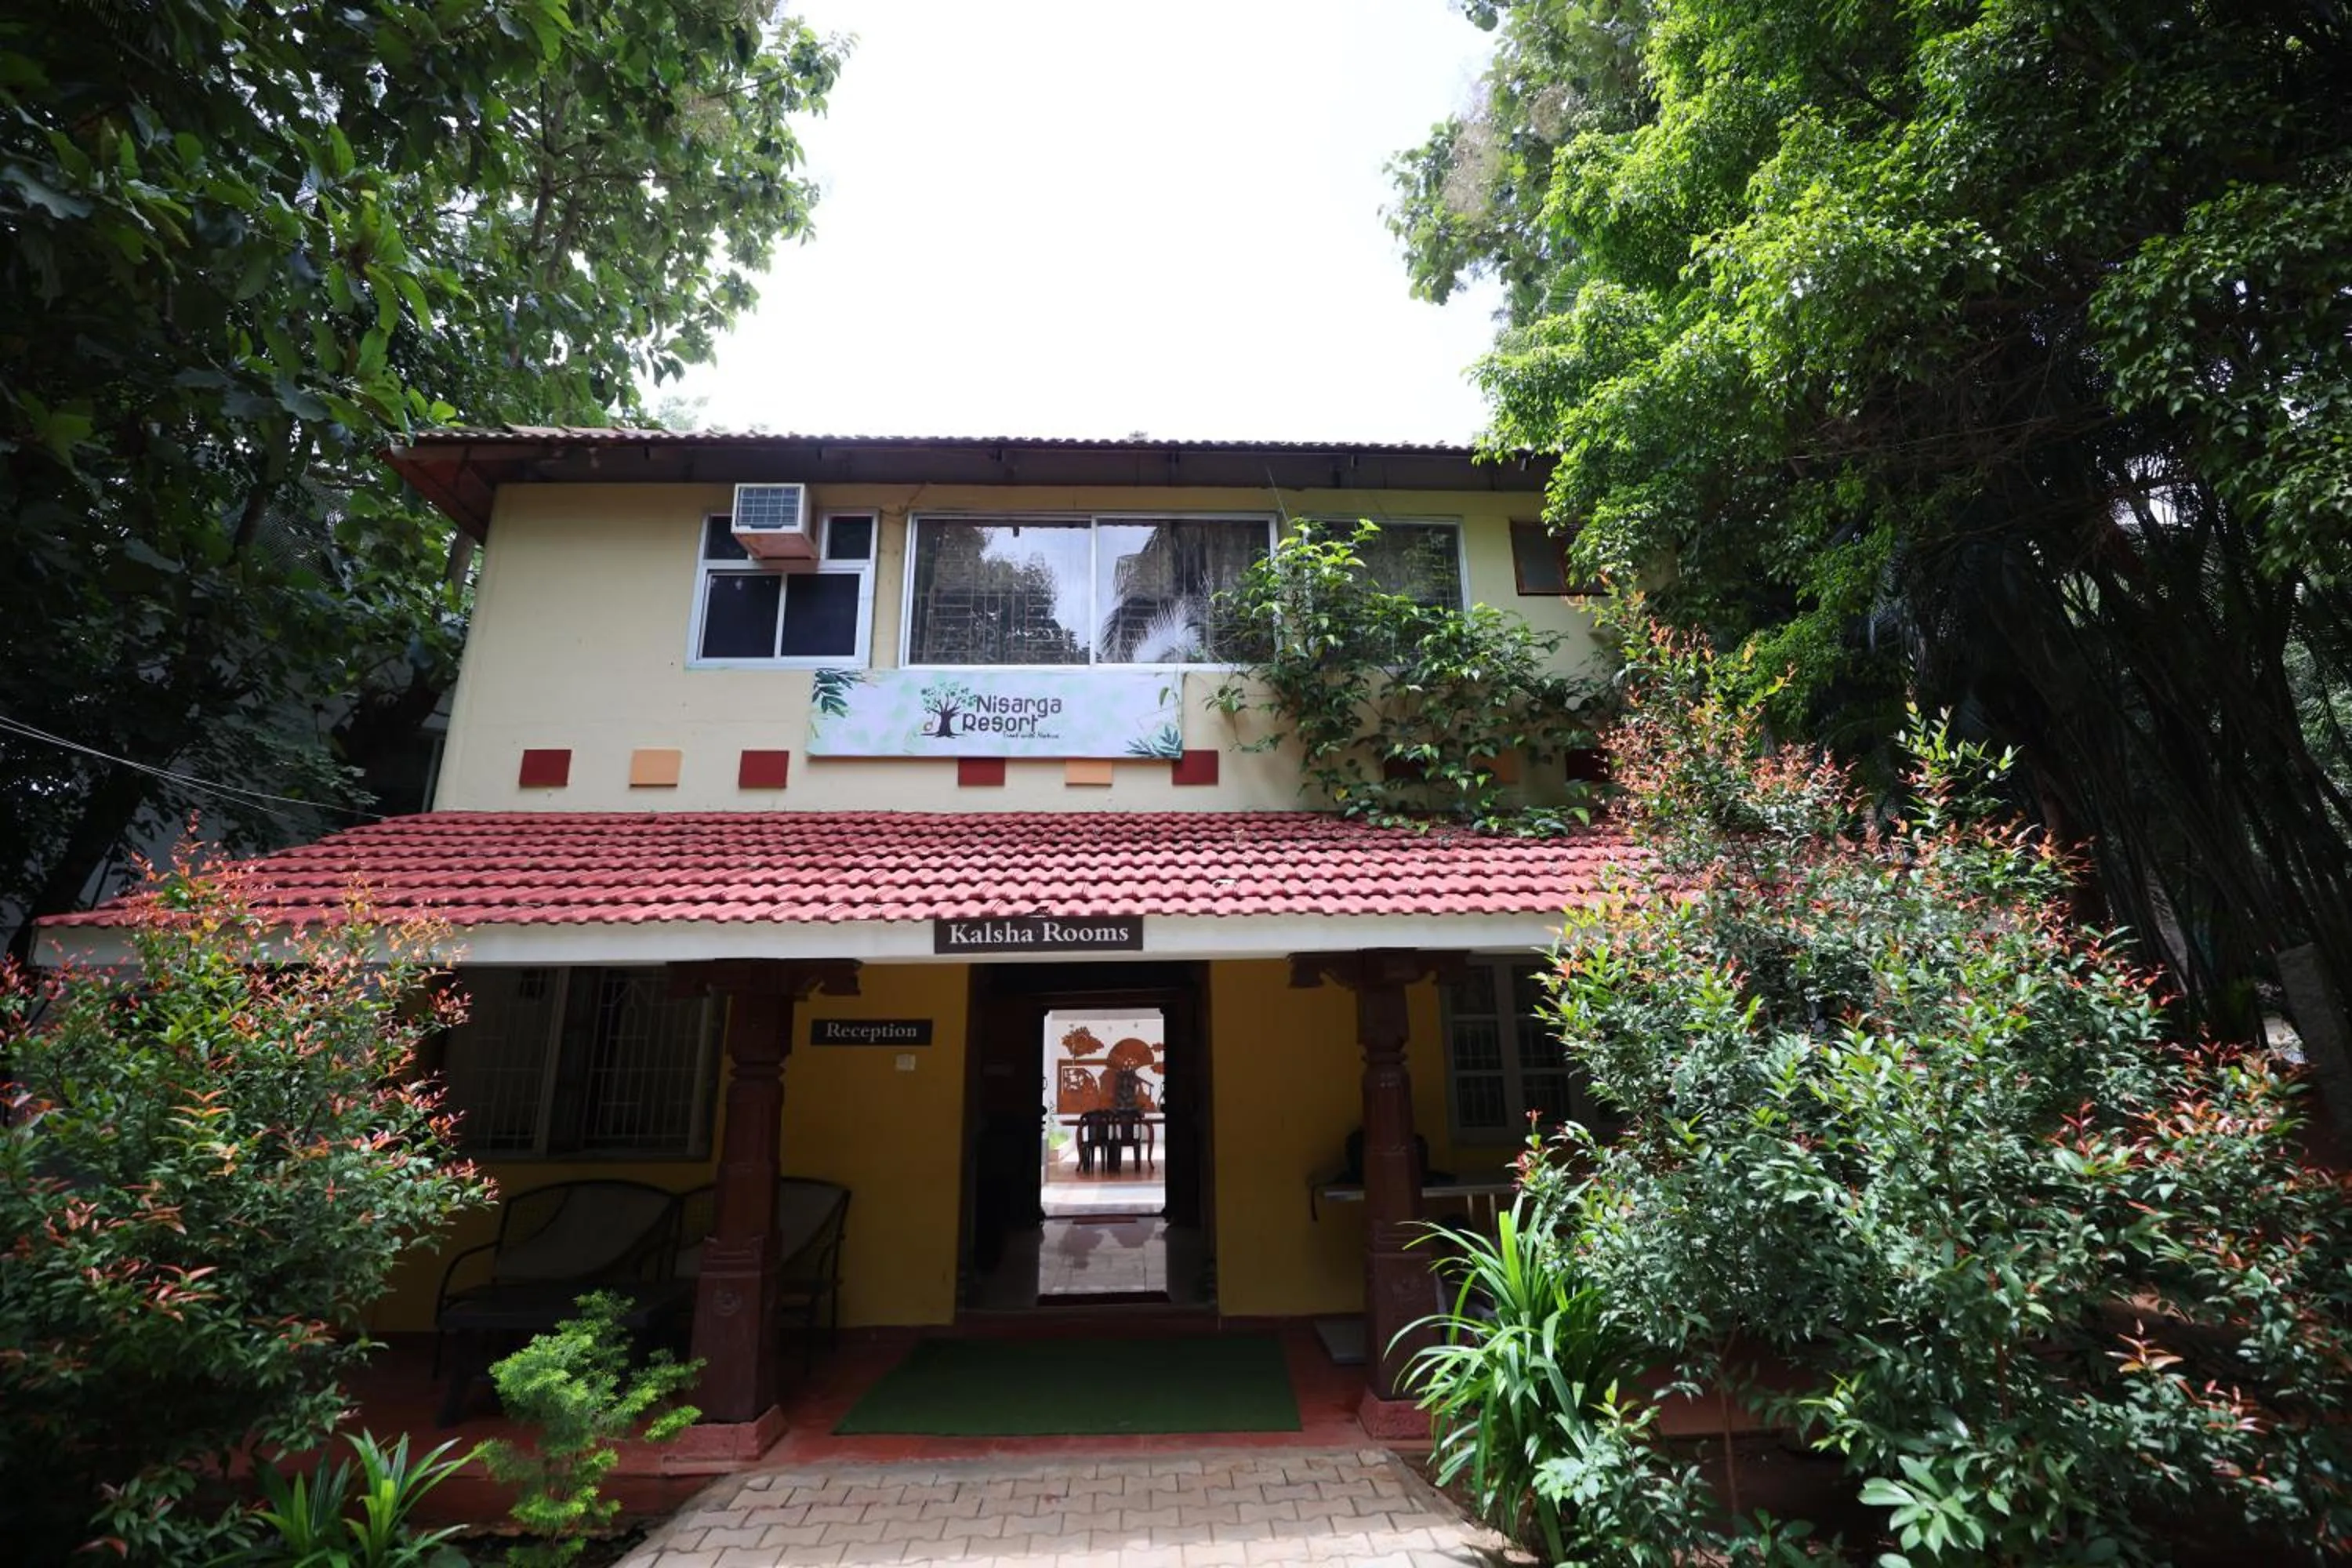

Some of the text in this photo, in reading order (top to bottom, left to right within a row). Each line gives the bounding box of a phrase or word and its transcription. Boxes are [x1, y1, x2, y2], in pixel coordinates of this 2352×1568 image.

[976, 695, 1062, 718] Nisarga
[962, 713, 1039, 732] Resort
[949, 921, 1129, 944] Kalsha Rooms
[826, 1022, 917, 1042] Reception
